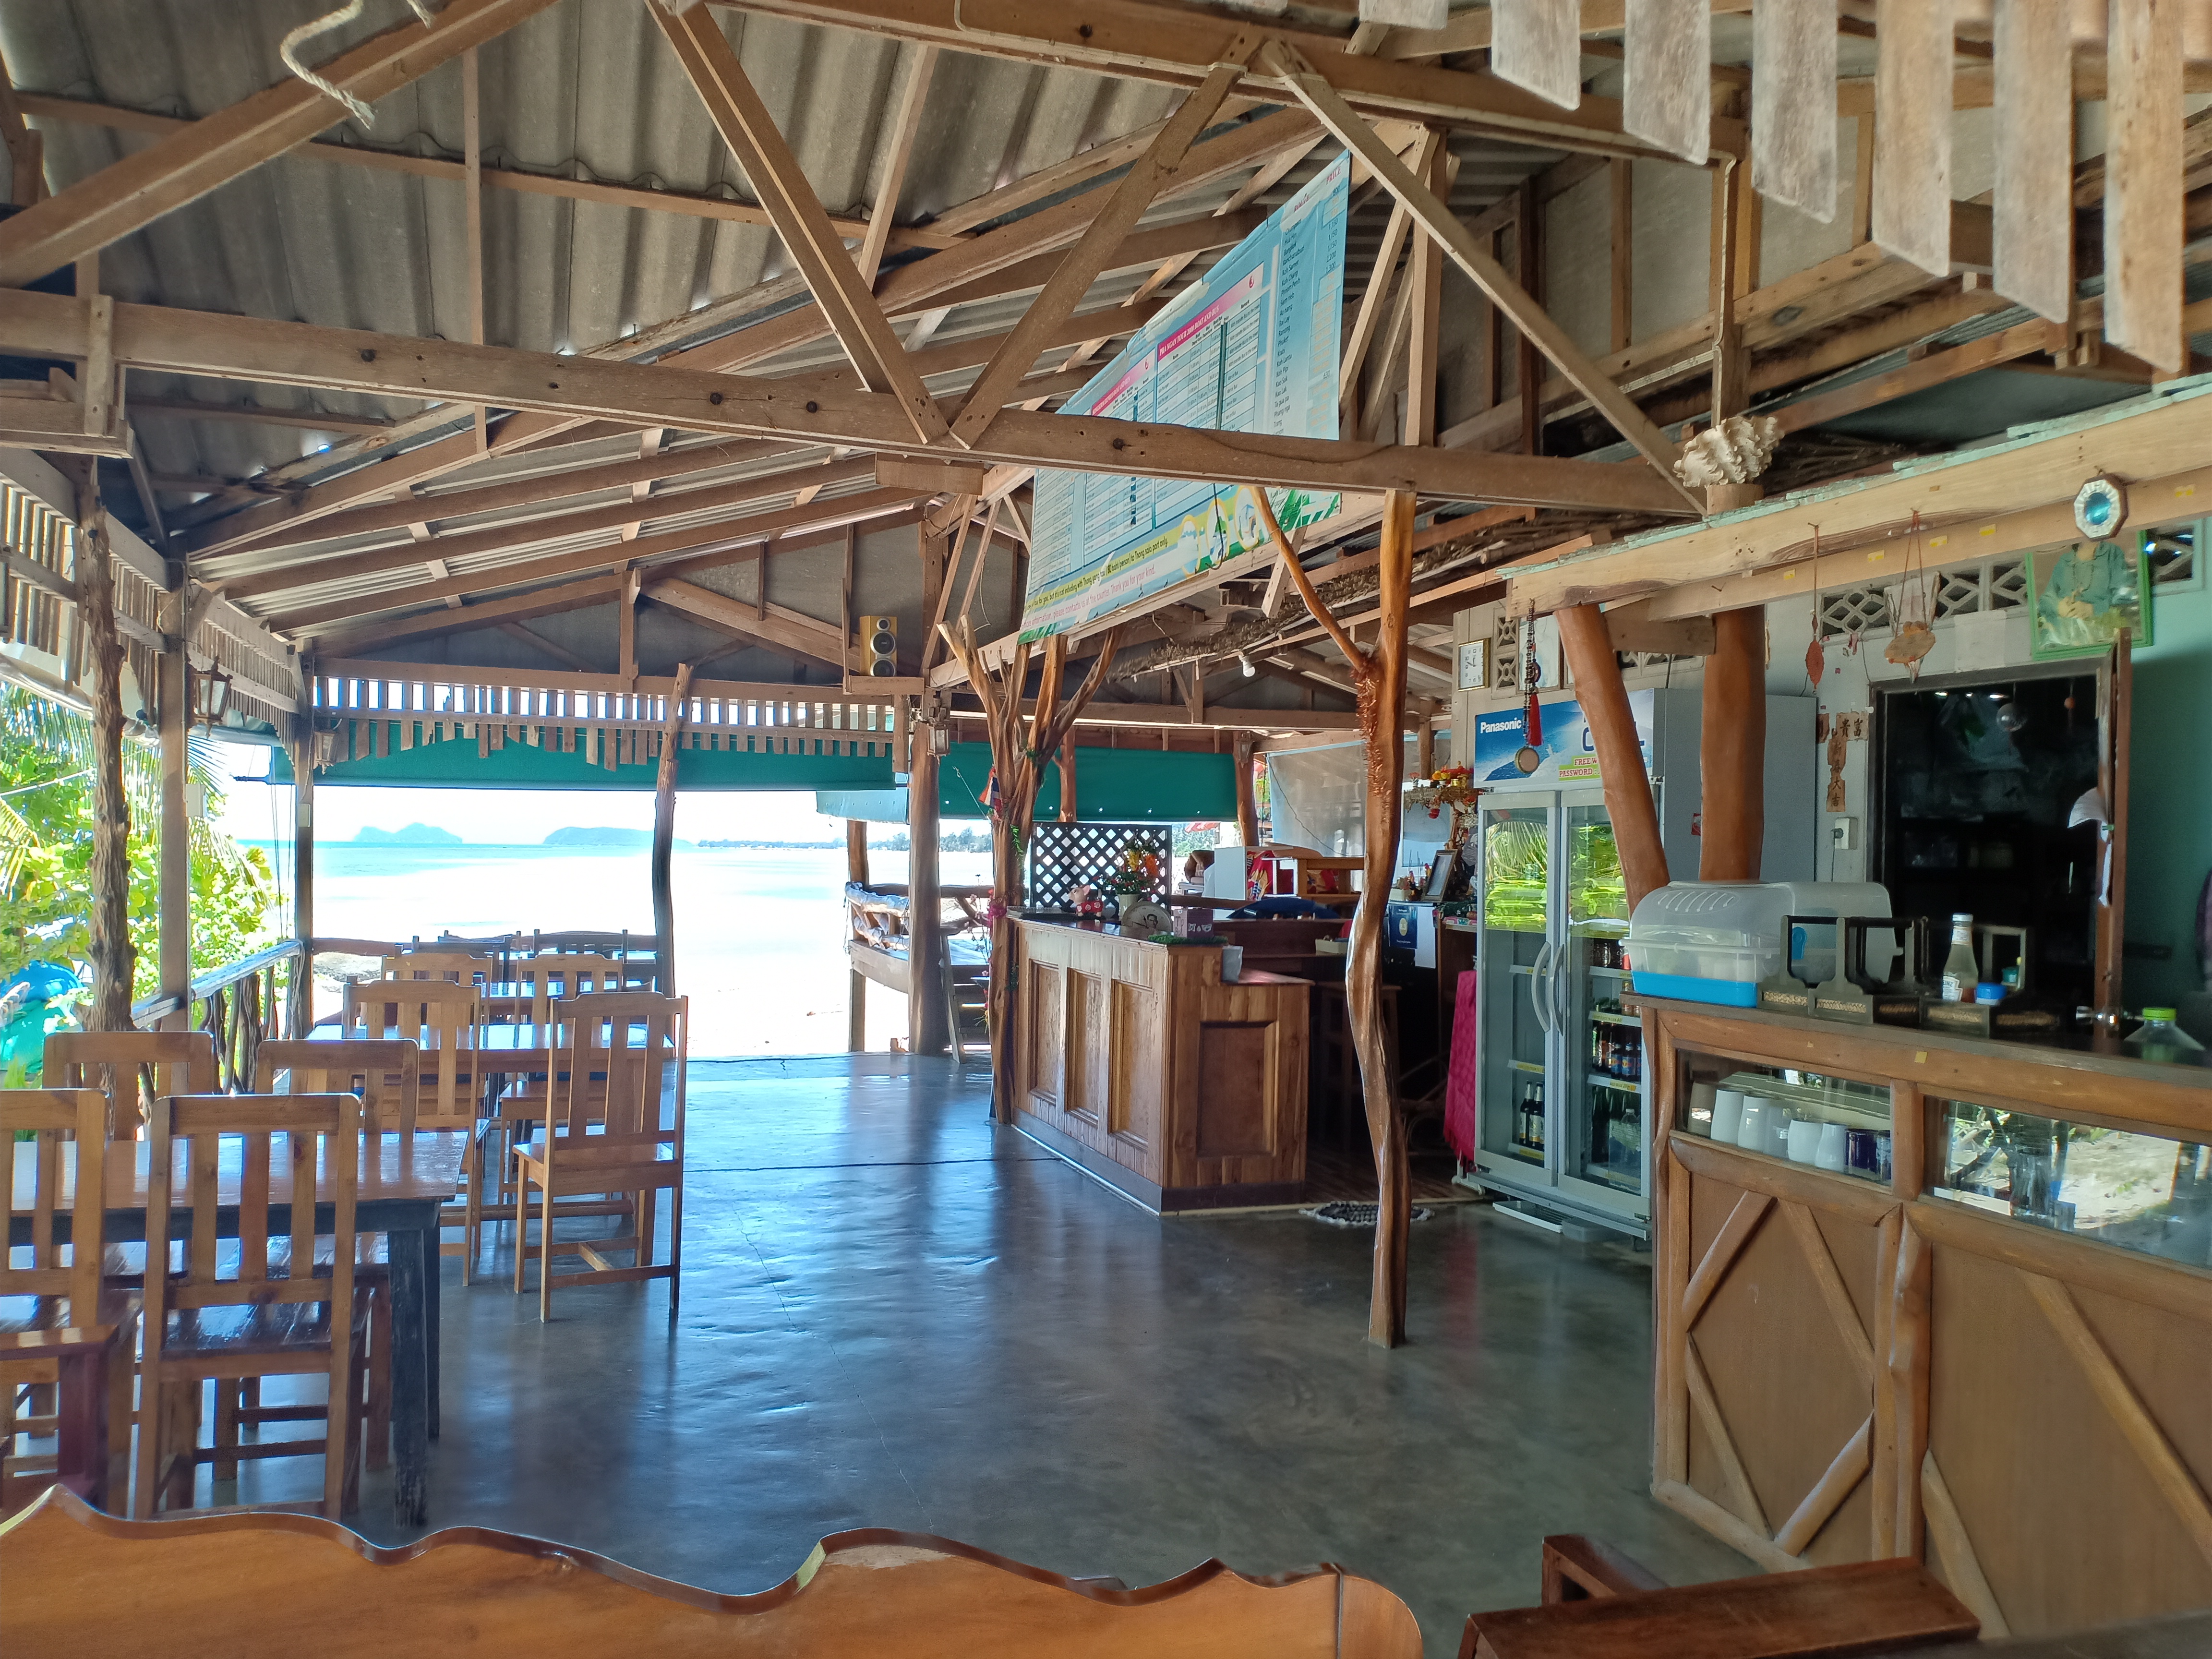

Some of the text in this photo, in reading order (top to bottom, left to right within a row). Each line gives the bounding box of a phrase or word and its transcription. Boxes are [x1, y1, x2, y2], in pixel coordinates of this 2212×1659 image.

[1326, 166, 1341, 185] PRICE
[1064, 584, 1077, 592] including
[1083, 576, 1092, 585] Thong
[1135, 551, 1145, 559] Thong
[1053, 607, 1065, 620] please
[1110, 581, 1122, 594] Thank
[1136, 572, 1145, 585] your
[1480, 718, 1522, 733] Panasonic
[1559, 769, 1593, 777] PASSWORD
